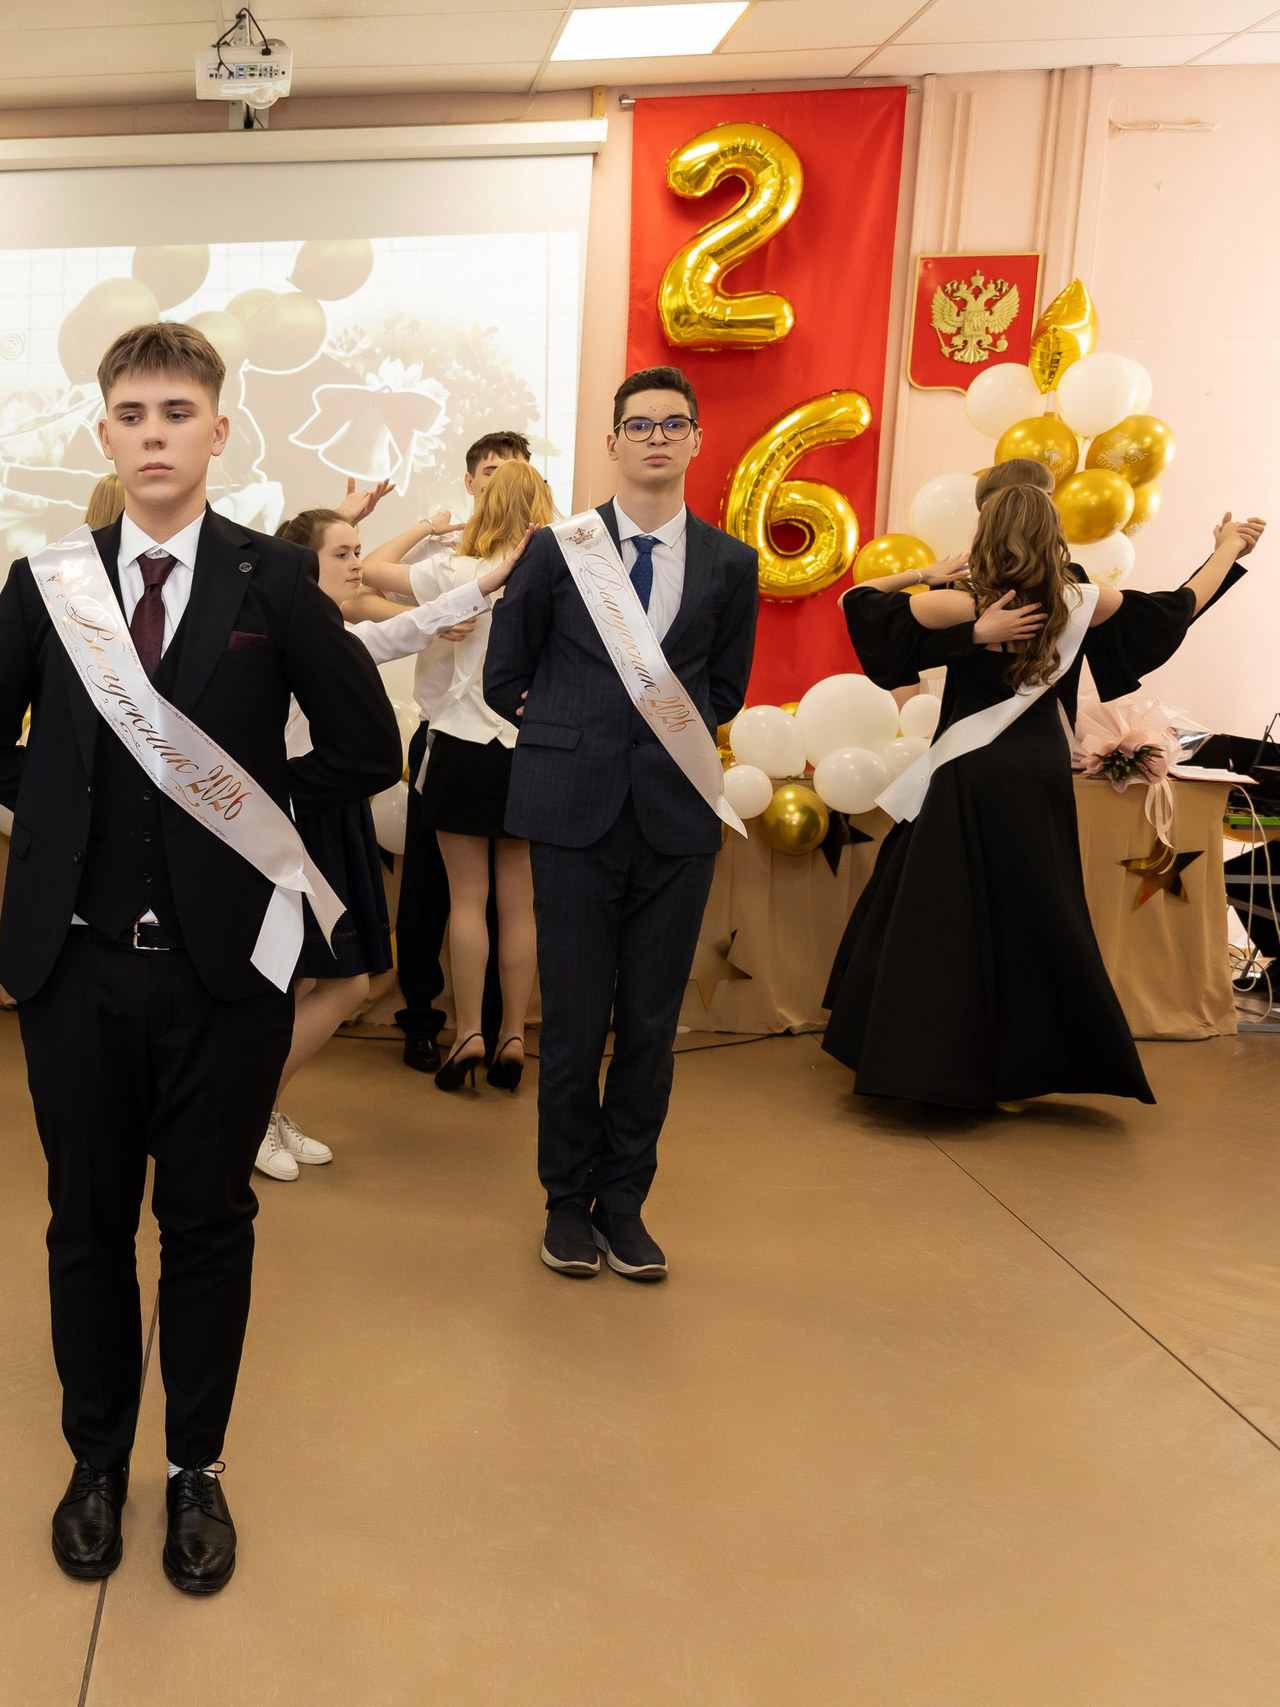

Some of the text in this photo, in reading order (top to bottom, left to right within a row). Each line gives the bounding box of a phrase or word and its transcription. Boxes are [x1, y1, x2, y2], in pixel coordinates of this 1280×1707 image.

[659, 122, 804, 350] 2
[721, 388, 872, 602] 6
[65, 594, 252, 820] Выпускник 2026
[581, 553, 696, 733] Выпускник 2026
